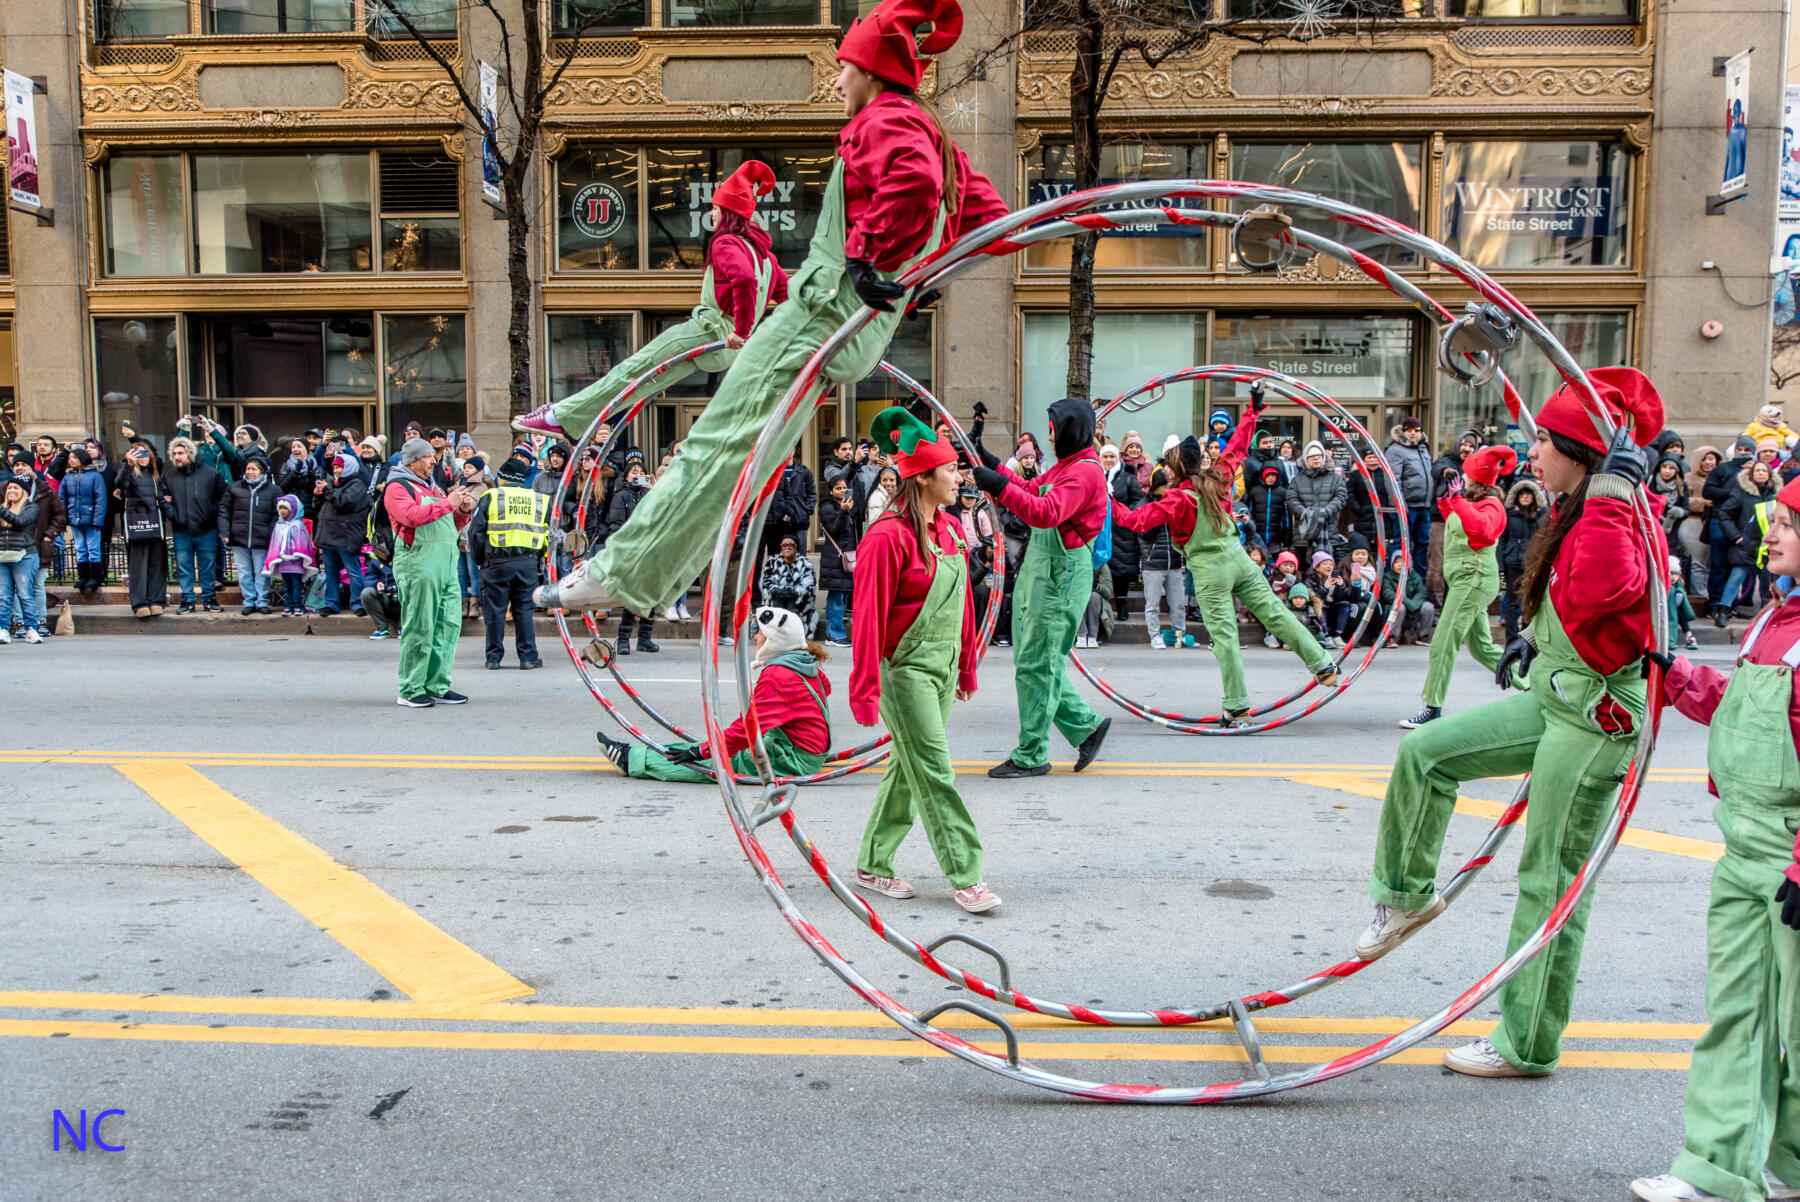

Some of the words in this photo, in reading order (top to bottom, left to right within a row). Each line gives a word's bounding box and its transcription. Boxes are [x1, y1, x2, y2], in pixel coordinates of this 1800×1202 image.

[576, 187, 597, 210] JIMMY
[689, 181, 795, 209] JIY
[1455, 182, 1609, 208] WINTRUST
[587, 199, 610, 223] JJ
[1569, 207, 1603, 217] BANK
[689, 210, 796, 237] JON'S
[1487, 217, 1525, 230] State
[1529, 217, 1574, 230] Street
[558, 350, 611, 368] FREE
[1268, 360, 1308, 373] State
[1312, 360, 1358, 374] Street
[508, 496, 532, 506] CHICAGO
[509, 505, 532, 515] POLICE
